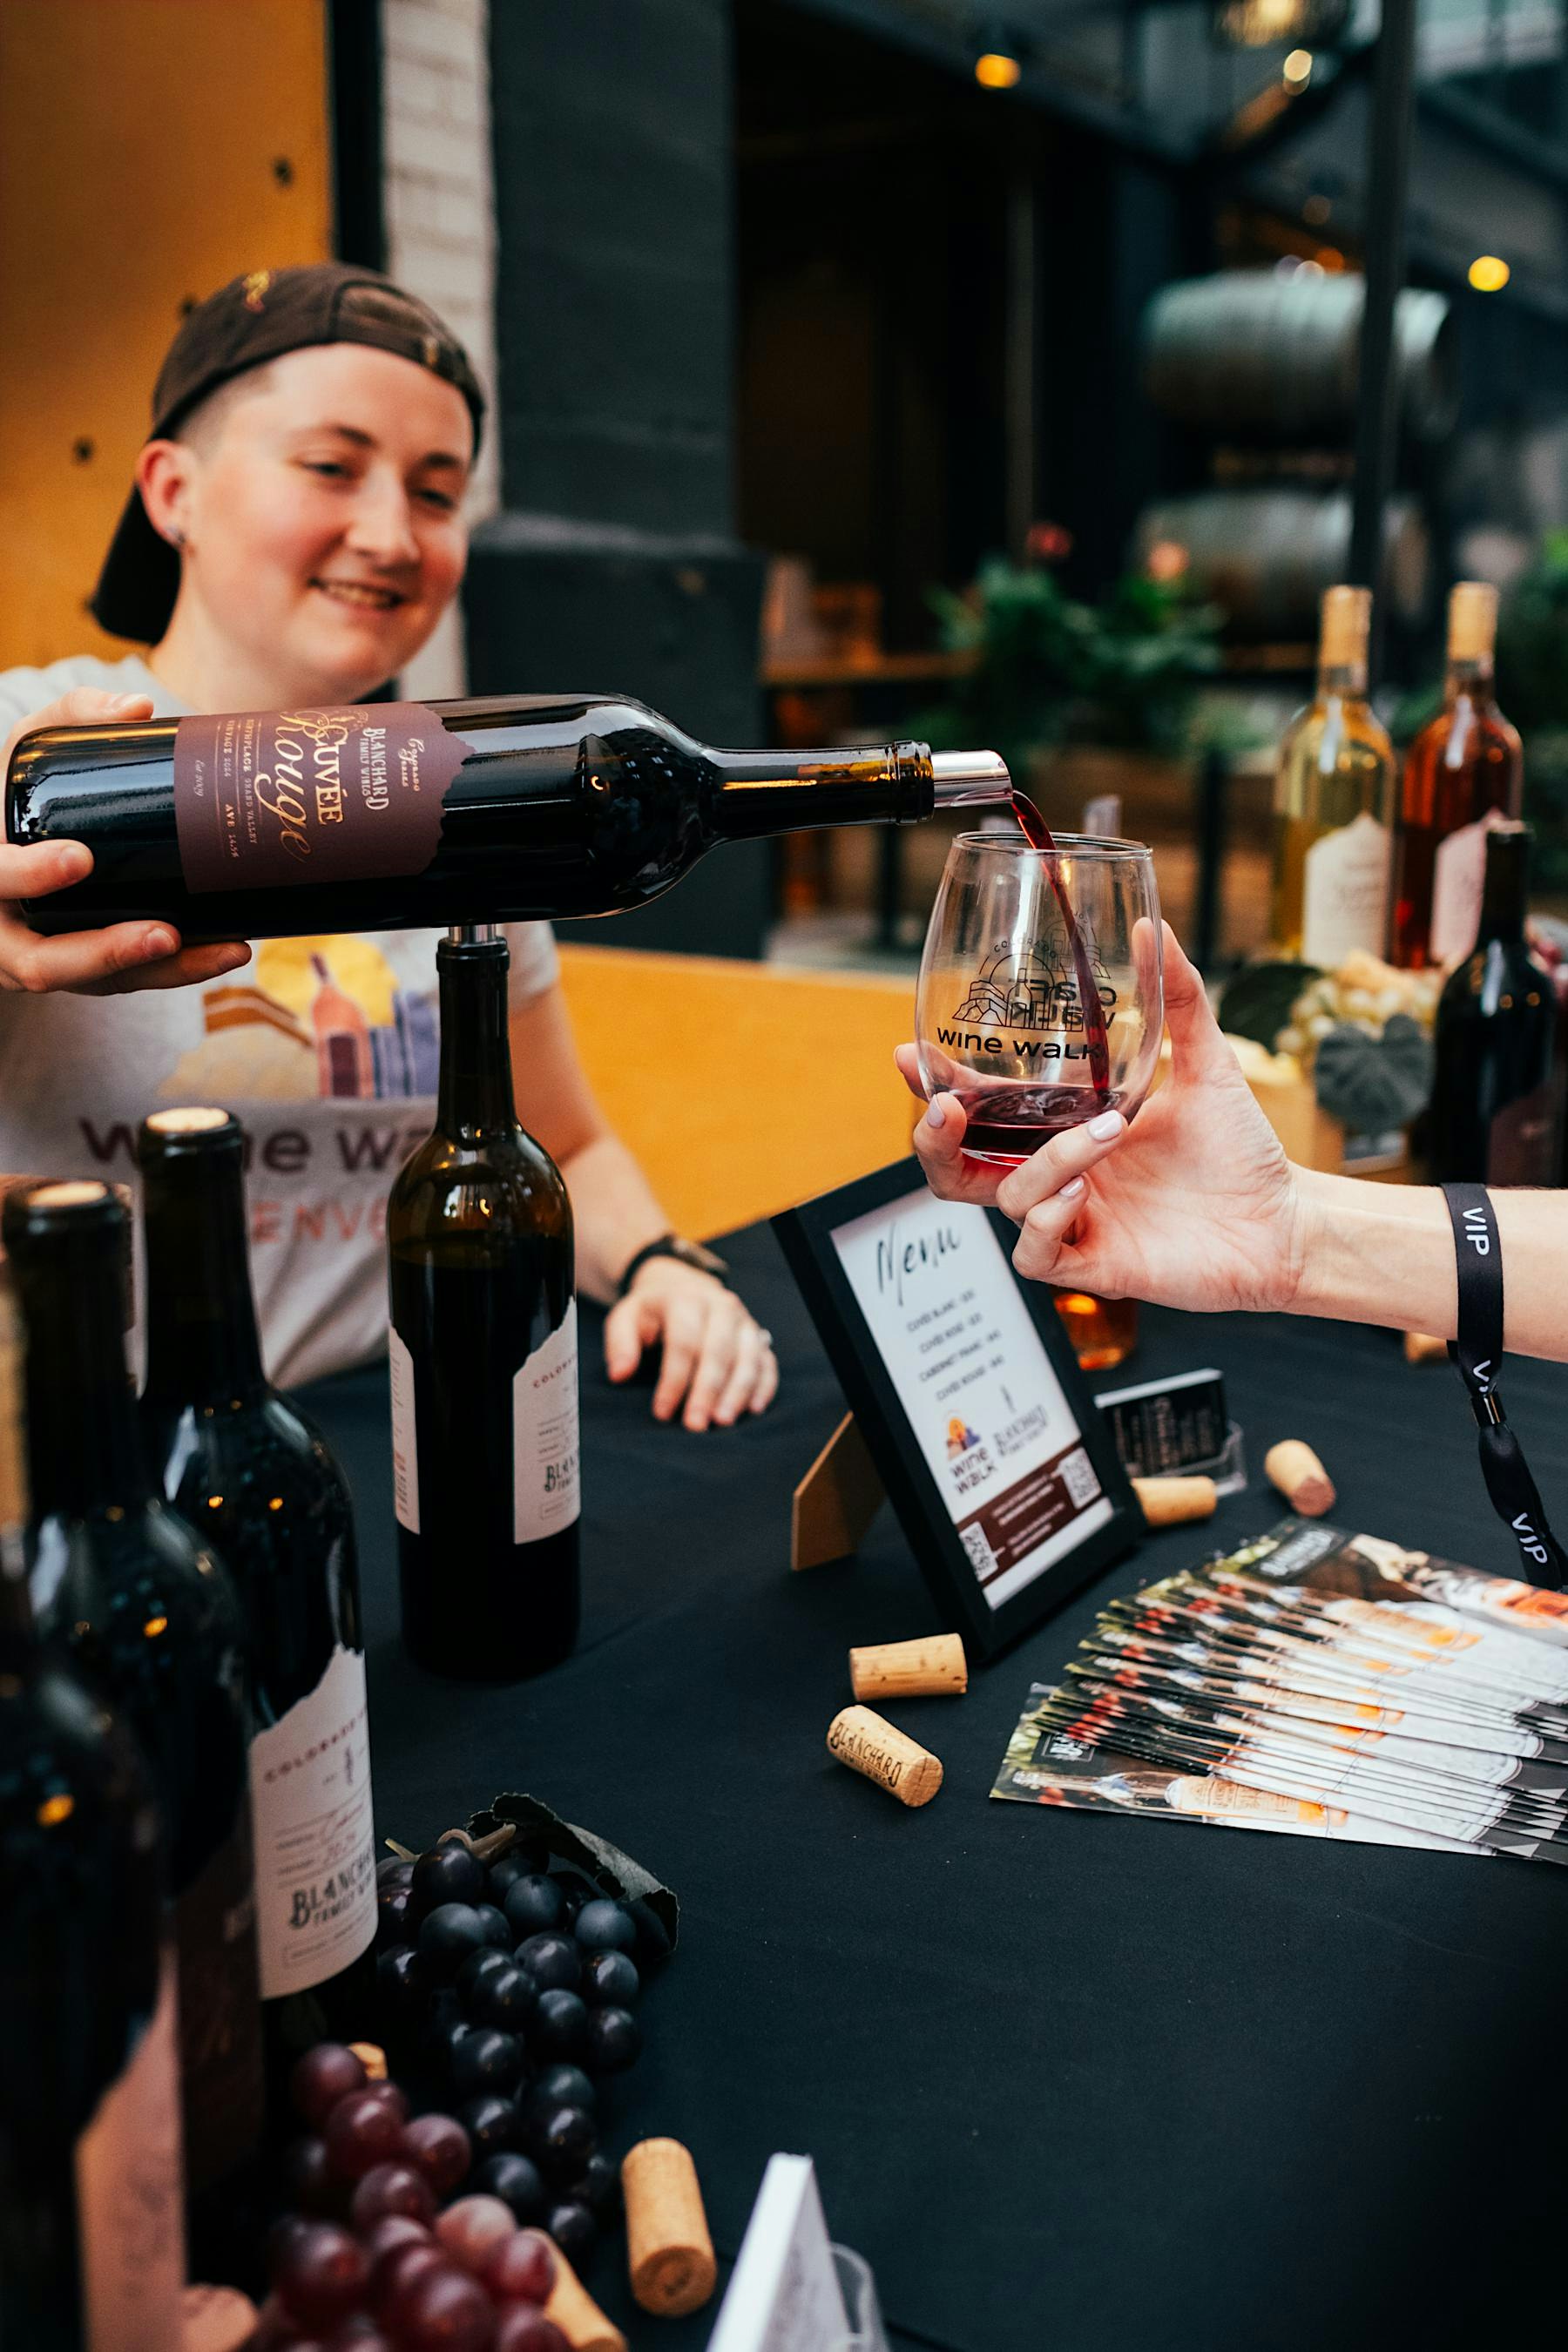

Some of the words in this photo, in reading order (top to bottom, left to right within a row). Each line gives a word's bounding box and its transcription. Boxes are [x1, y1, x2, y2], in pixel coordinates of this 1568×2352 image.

[360, 738, 370, 764] FAMILY
[362, 727, 389, 810] BLANCHARD
[254, 711, 330, 863] Rouge
[361, 766, 372, 796] WINES
[1463, 1207, 1490, 1255] VIP
[878, 1221, 962, 1307] Menu
[1512, 1512, 1548, 1564] VIP
[830, 1721, 902, 1788] BLANCHARD
